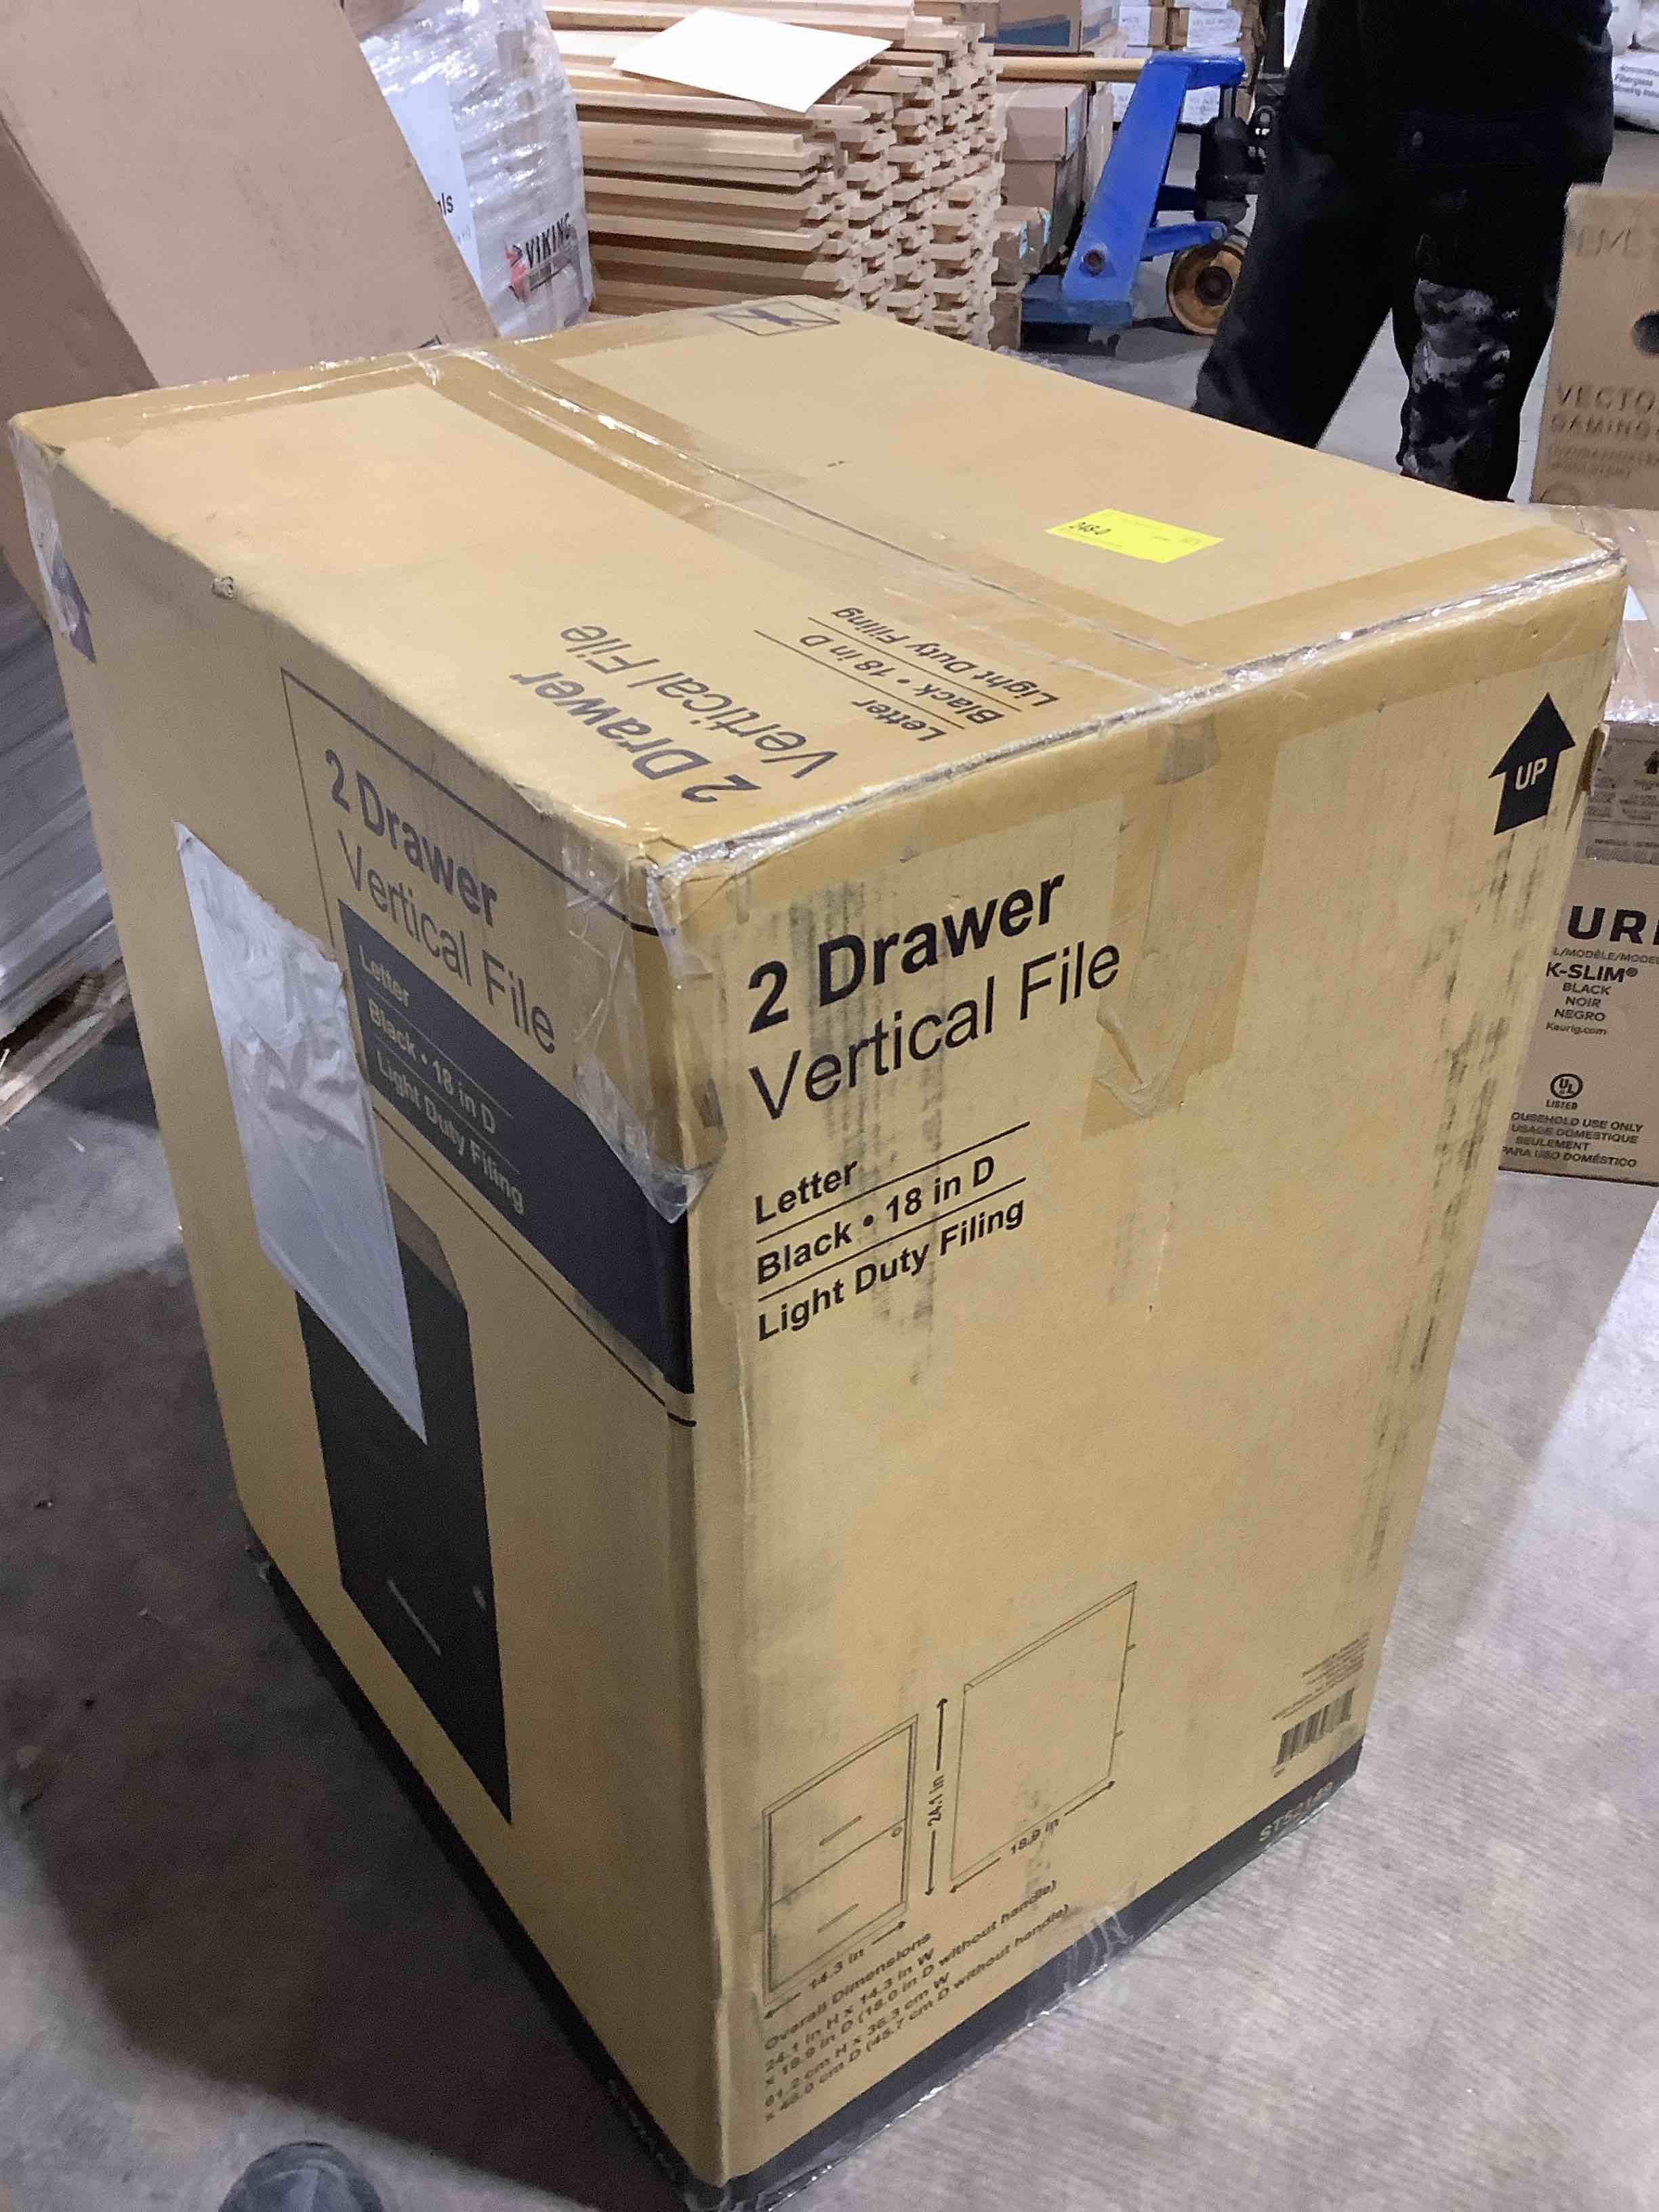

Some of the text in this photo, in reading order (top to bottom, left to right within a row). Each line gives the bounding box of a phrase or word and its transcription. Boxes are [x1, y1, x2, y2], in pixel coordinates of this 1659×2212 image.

[1557, 384, 1659, 415] VECTO
[800, 634, 1004, 724] Black 18 in D
[830, 607, 1059, 707] Light Duty Filing
[509, 672, 762, 802] 2 Drawer
[560, 626, 840, 779] Vertical File
[851, 699, 947, 741] Letter
[1515, 758, 1548, 792] UP
[325, 748, 498, 927] 2 Drawer
[337, 828, 554, 1054] Vertical File
[360, 945, 409, 1007] Letter
[748, 874, 1065, 1033] 2 Drawer
[748, 941, 1120, 1120] Vertical File
[1545, 1021, 1607, 1035] Keurig.com
[1554, 1008, 1605, 1022] NEGRO
[1562, 982, 1612, 995] BLACK
[1565, 996, 1601, 1008] NOIR
[369, 998, 495, 1134] Black 18 in D
[1545, 1099, 1578, 1110] LISTED
[377, 1050, 525, 1215] Light Duty Filing
[1511, 1124, 1639, 1144] USAGE DOMESTIQUE
[1515, 1136, 1591, 1151] SEULEMENT
[1563, 1153, 1637, 1168] DOMÉSTICO
[1582, 1119, 1608, 1130] USE
[1610, 1122, 1644, 1132] ONLY
[755, 1160, 857, 1225] Letter
[757, 1156, 995, 1285] Black 18 in D
[759, 1200, 1024, 1341] Light Duty Filing
[927, 1775, 944, 1826] 24.1 in
[764, 1933, 930, 2050] Overall Dimensions
[805, 2030, 821, 2044] in
[827, 2013, 838, 2030] H
[898, 1966, 912, 1980] in
[918, 1948, 934, 1965] W
[820, 2034, 835, 2049] in
[842, 2020, 853, 2034] D
[903, 1978, 917, 1992] in
[922, 1965, 935, 1978] D
[939, 1921, 996, 1966] without
[1001, 1880, 1057, 1924] handle)
[848, 1948, 863, 1964] in
[849, 2049, 861, 2063] D
[909, 2001, 933, 2021] cm
[938, 1987, 949, 2001] D
[954, 1944, 1010, 1989] without
[1015, 1904, 1069, 1947] handle)
[835, 2044, 846, 2057] H
[905, 1990, 928, 2010] cm
[934, 1972, 949, 1989] W
